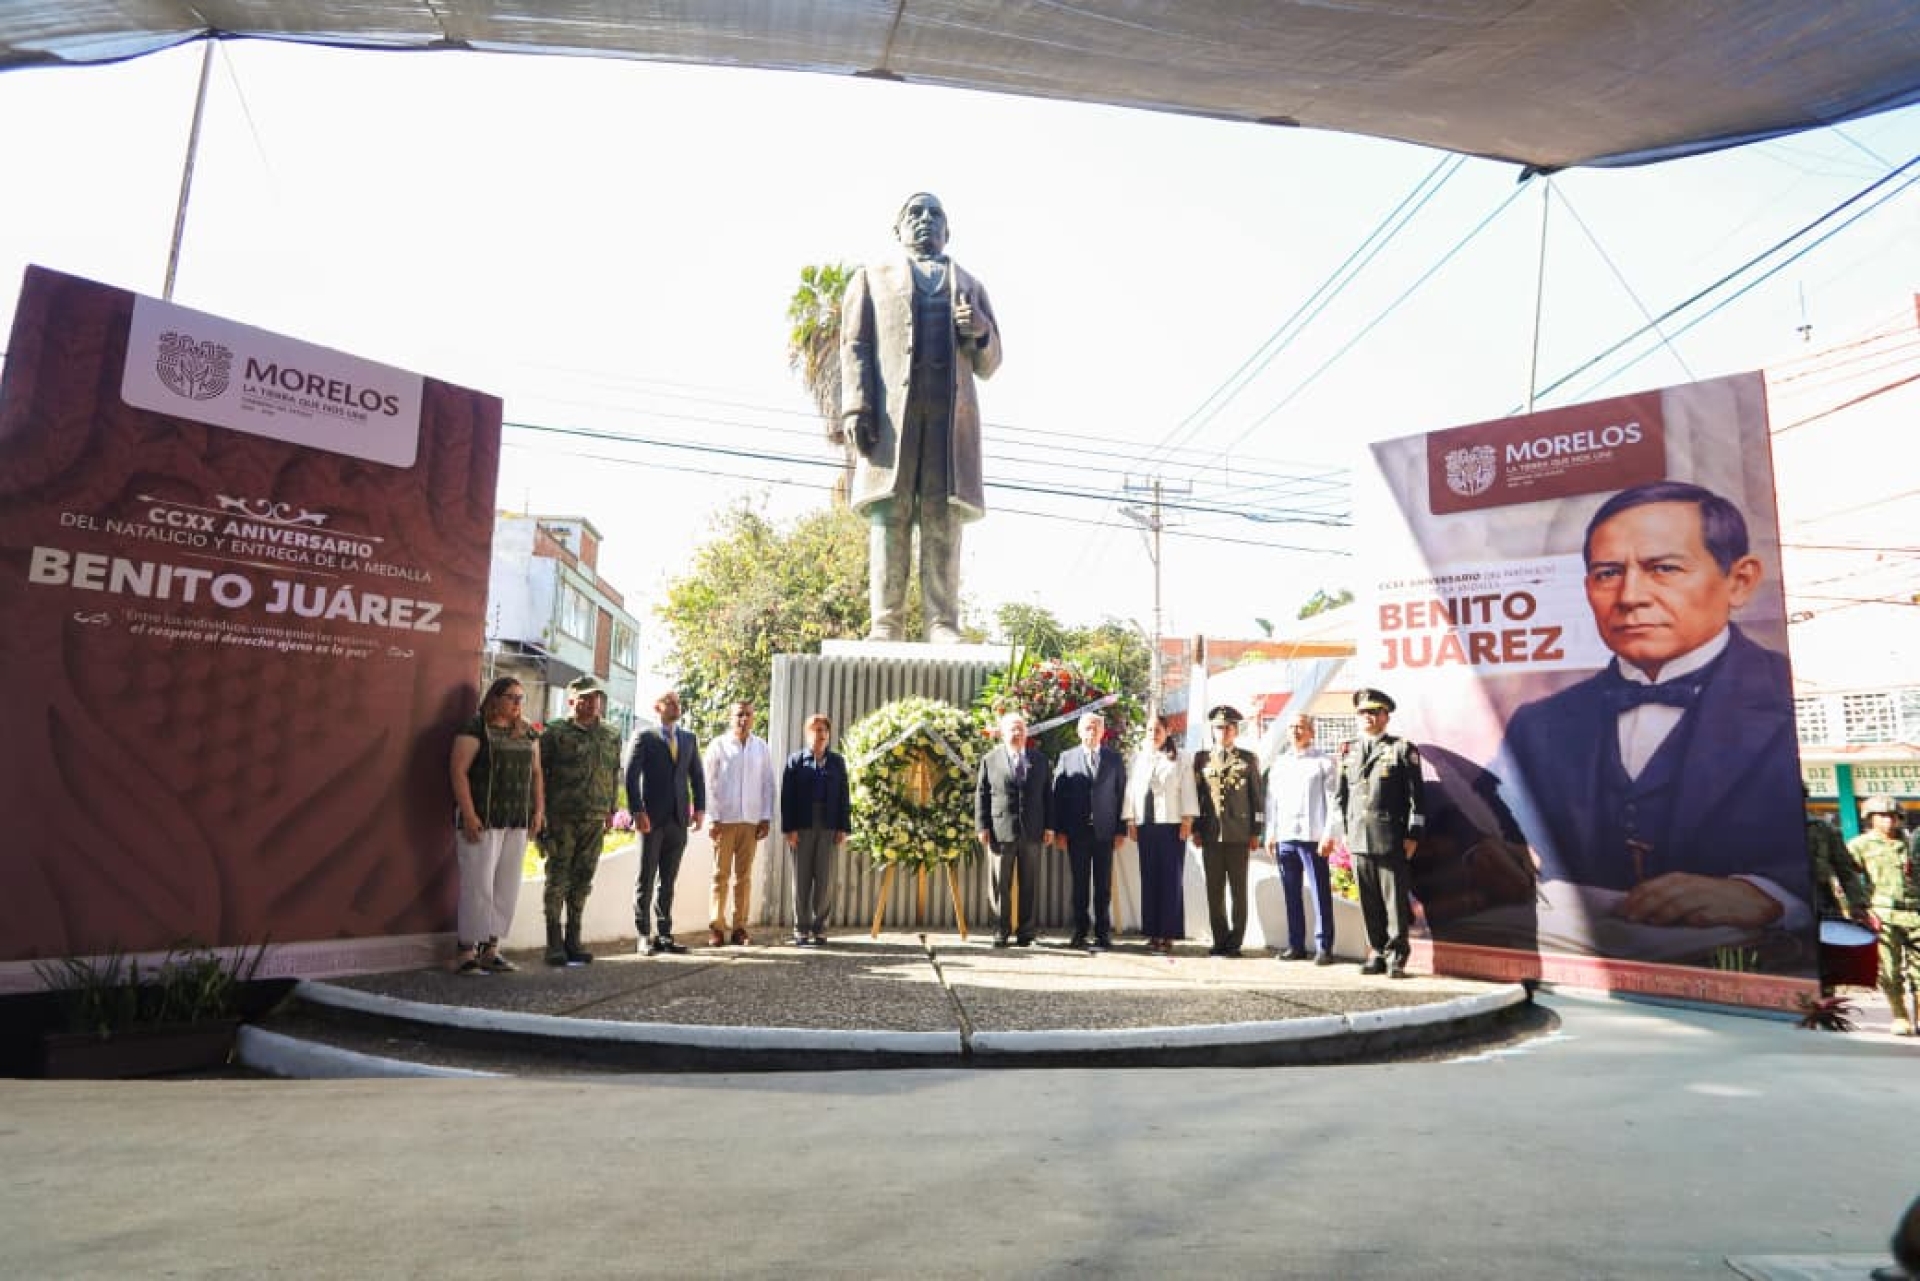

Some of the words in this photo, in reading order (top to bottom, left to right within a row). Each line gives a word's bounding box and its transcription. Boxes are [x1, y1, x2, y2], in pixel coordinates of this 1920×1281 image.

[245, 357, 399, 416] MORELOS
[1505, 422, 1643, 464] MORELOS
[60, 512, 99, 531] DEL
[106, 519, 207, 547] NATALICIO
[214, 536, 226, 550] Y
[231, 540, 309, 563] ENTREGA
[315, 553, 336, 568] DE
[341, 556, 359, 571] LA
[365, 561, 431, 583] MEDALLA
[149, 508, 216, 532] CCXX
[223, 520, 373, 558] ANIVERSARIO
[28, 546, 253, 608] BENITO
[265, 579, 444, 633] JUÁREZ
[1379, 591, 1537, 631] BENITO
[1379, 625, 1564, 670] JUÁREZ
